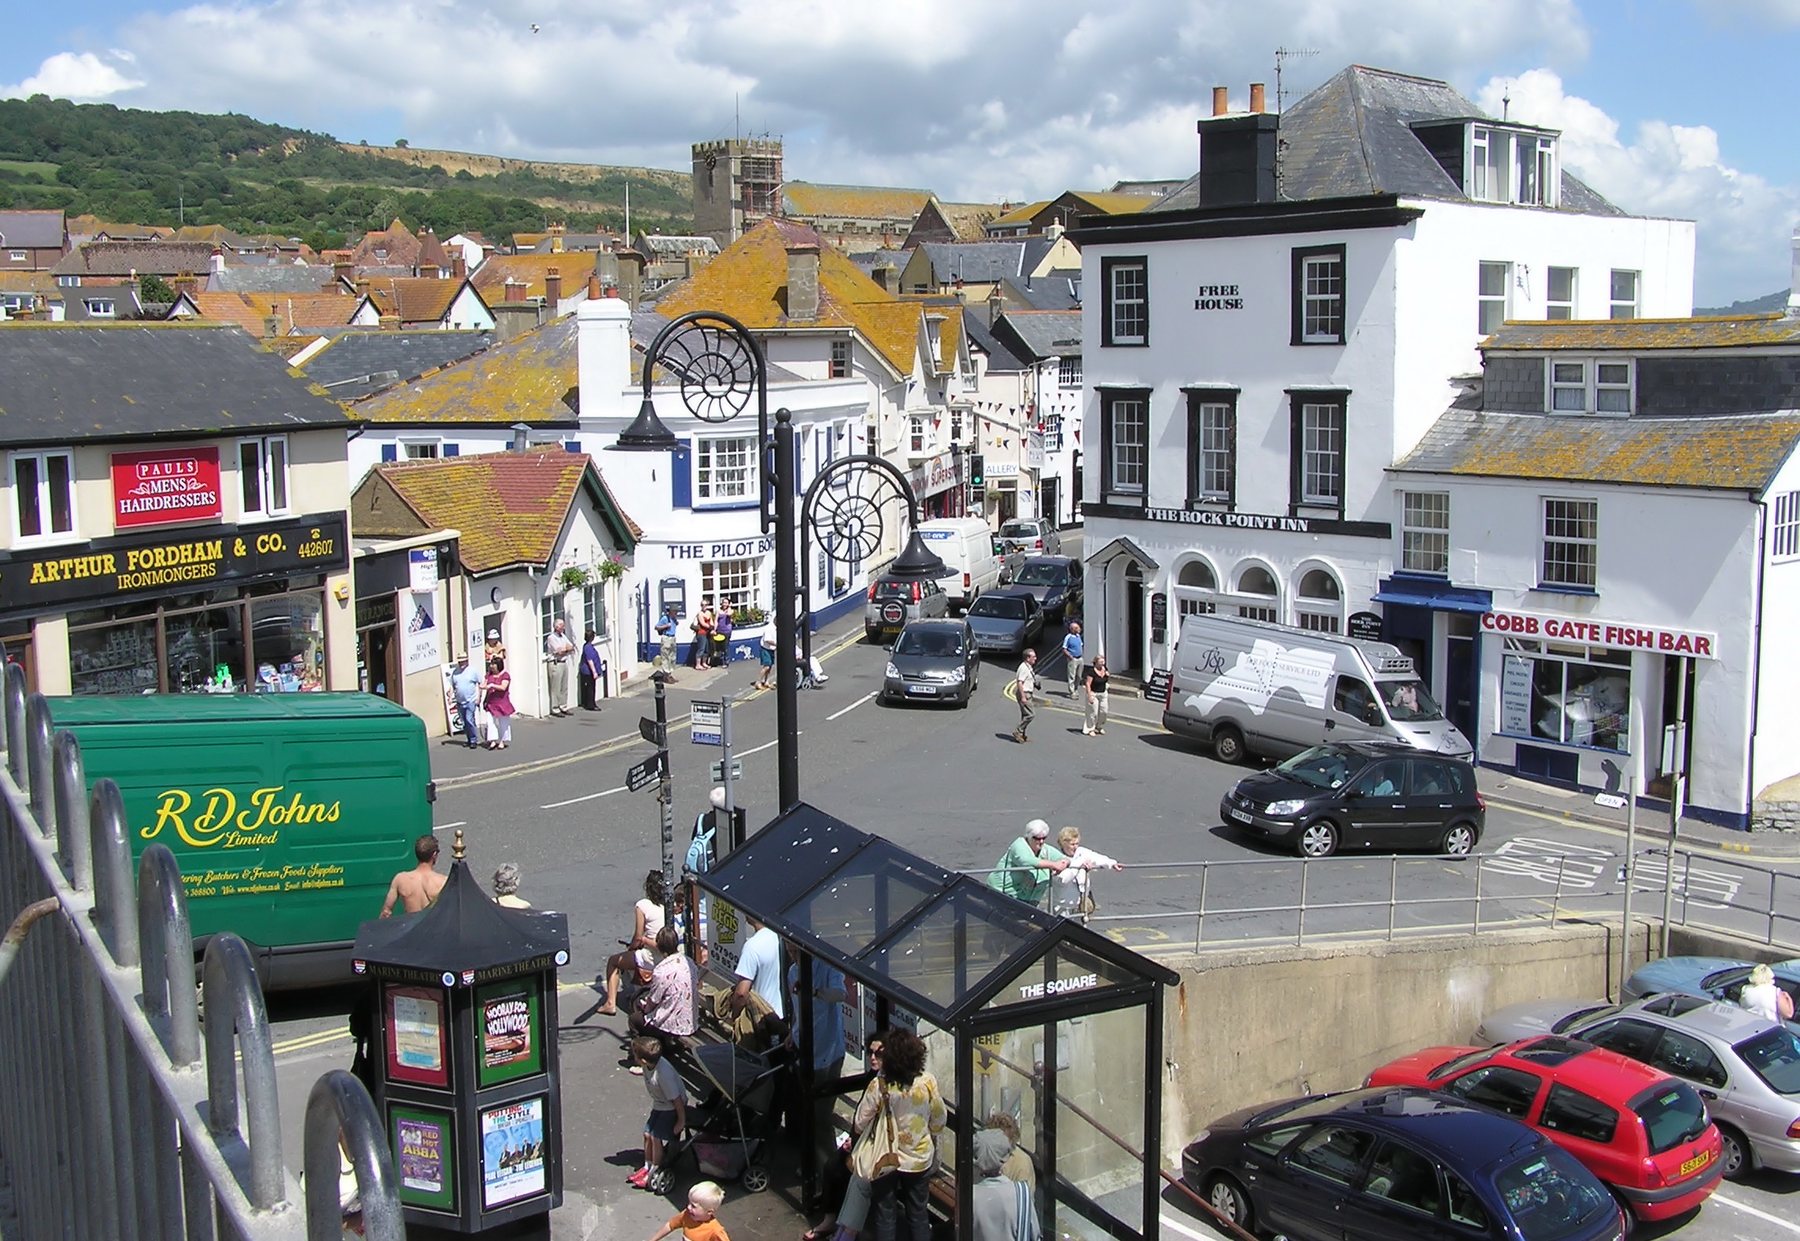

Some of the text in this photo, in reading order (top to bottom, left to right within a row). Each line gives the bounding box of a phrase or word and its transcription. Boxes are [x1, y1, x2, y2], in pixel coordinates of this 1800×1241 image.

[1199, 285, 1239, 296] FREE
[1194, 299, 1243, 310] HOUSE
[140, 461, 195, 476] PAULS
[985, 464, 1018, 474] ALLERY
[150, 477, 188, 494] MENS
[120, 491, 217, 514] HAIRDRESSERS
[1145, 508, 1309, 531] THE ROCK POINT INN
[298, 539, 334, 558] 442607
[667, 545, 704, 559] THE
[711, 541, 754, 558] PILOT
[30, 532, 287, 584] ARTHUR FORDHAM & CO.
[117, 562, 217, 589] IRONMONGERS
[1482, 612, 1710, 655] COBB GATE FISH BAR
[1195, 647, 1225, 675] J&R
[1279, 663, 1305, 675] SERVICE
[140, 786, 341, 847] R D Johns
[222, 830, 278, 848] Limited
[204, 869, 239, 884] Butchers
[241, 869, 251, 880] &
[250, 867, 280, 881] Frozen
[280, 865, 306, 879] Foods
[307, 863, 344, 878] Suppliers
[712, 907, 739, 933] REGIS
[369, 964, 401, 978] MARINE
[477, 956, 552, 980] MARINE THEATRE
[1020, 974, 1097, 998] THE SQUARE
[486, 1001, 527, 1019] HOORAY FOR
[487, 1014, 528, 1036] HOLLYWOOD
[488, 1103, 522, 1119] PUTTING
[493, 1115, 507, 1124] THE
[507, 1109, 530, 1121] STYLE
[422, 1130, 438, 1139] RED
[422, 1139, 439, 1147] HOT
[403, 1144, 439, 1159] ABBA
